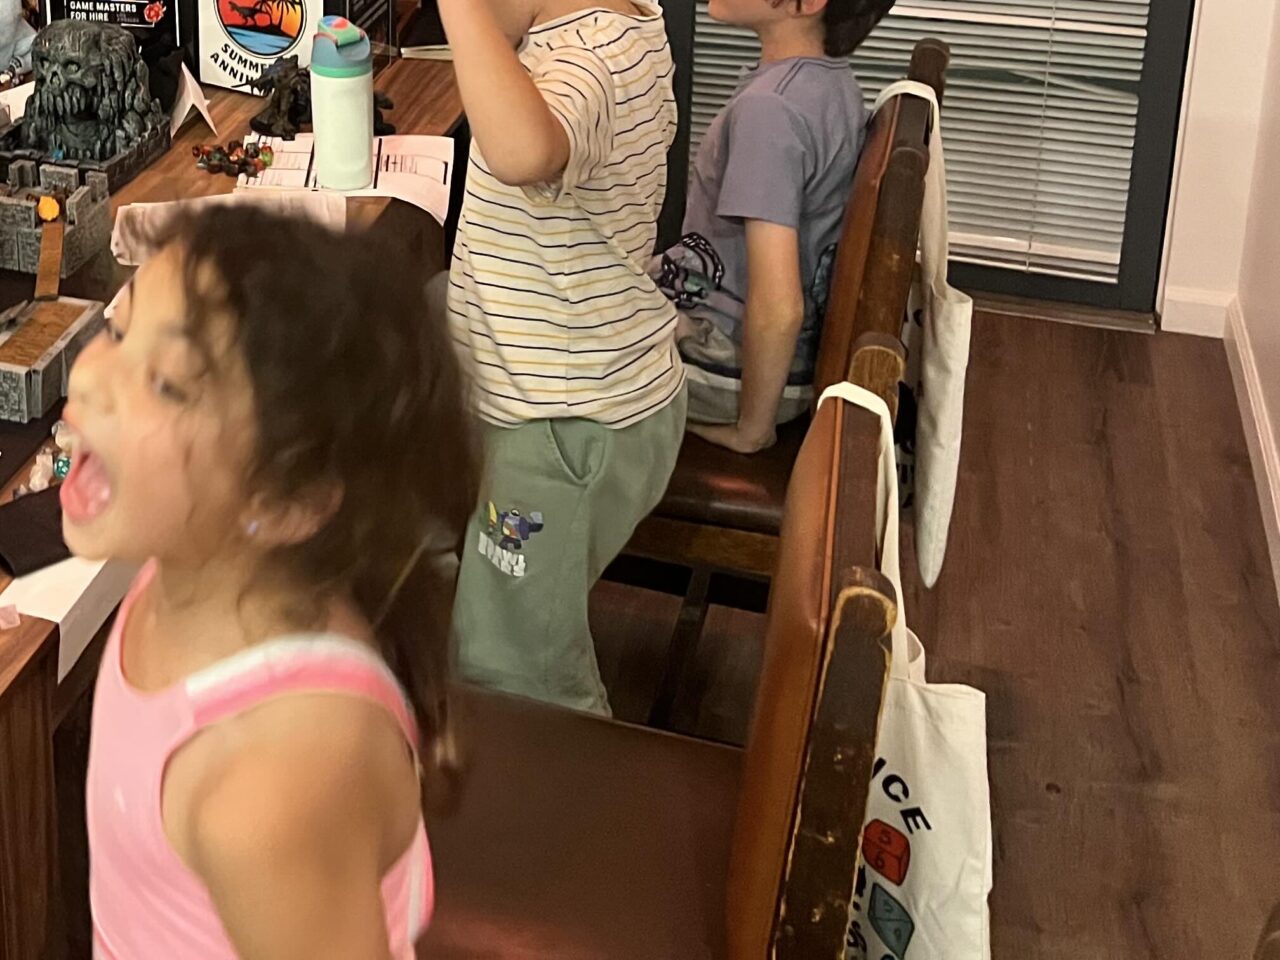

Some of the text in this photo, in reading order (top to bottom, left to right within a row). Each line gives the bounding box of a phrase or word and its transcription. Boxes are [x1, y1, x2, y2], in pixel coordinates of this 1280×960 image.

[69, 1, 137, 13] GAME MASTERS
[70, 11, 87, 21] FOR
[89, 12, 109, 22] HIRE
